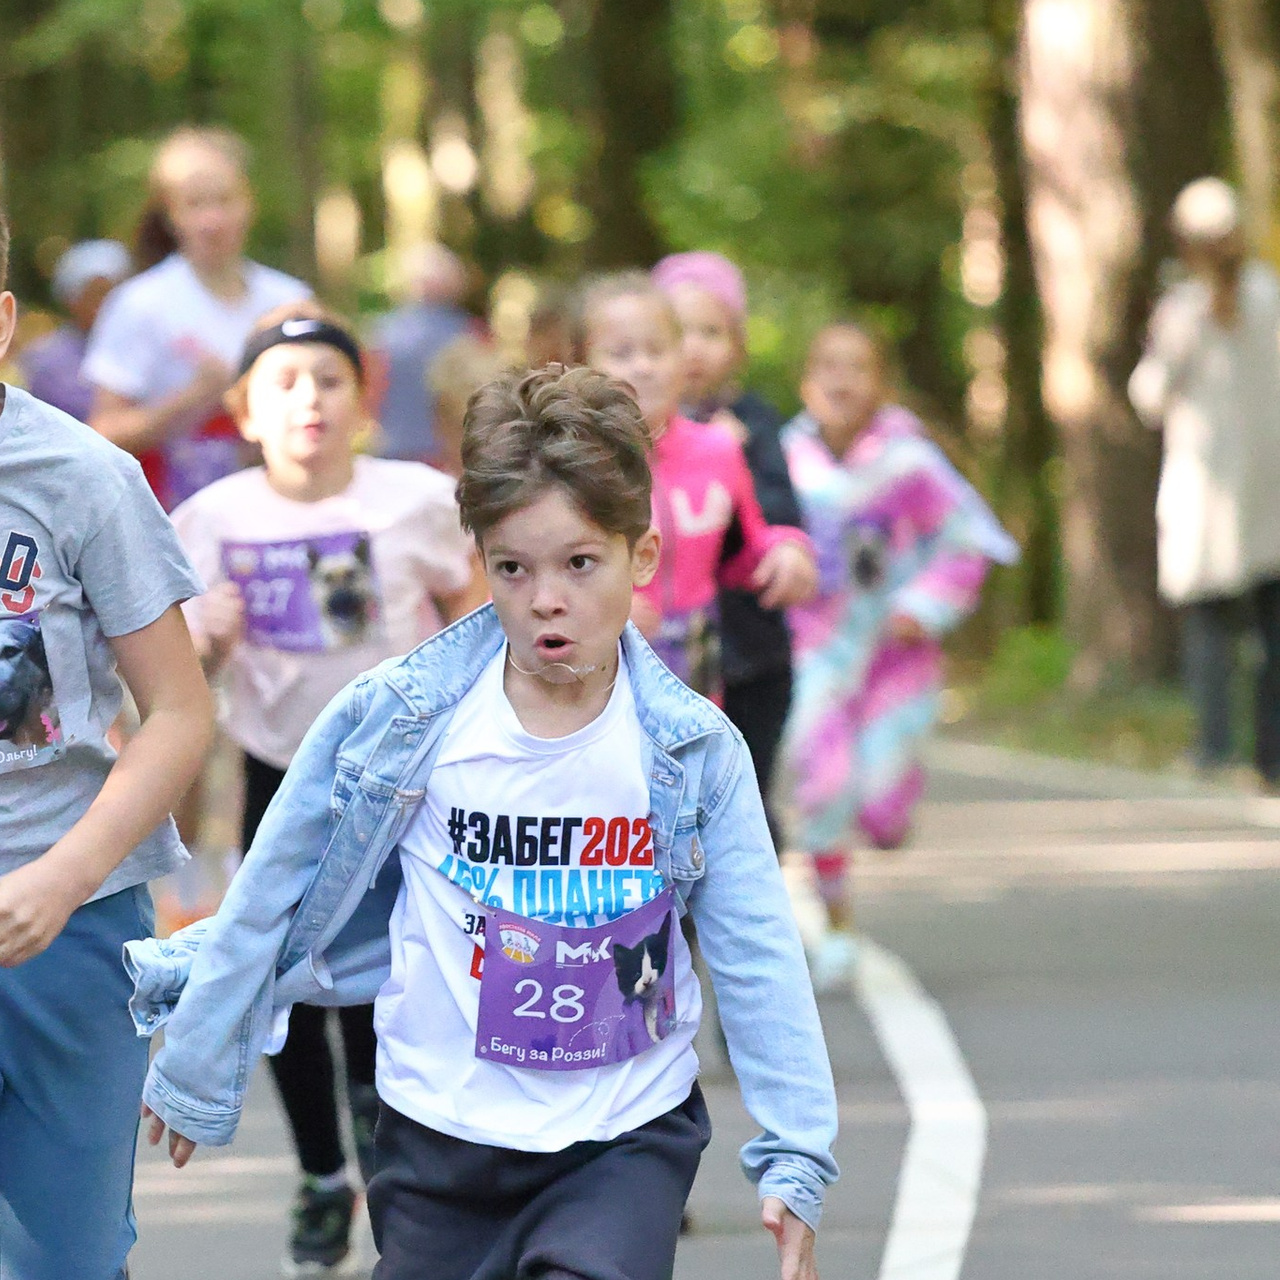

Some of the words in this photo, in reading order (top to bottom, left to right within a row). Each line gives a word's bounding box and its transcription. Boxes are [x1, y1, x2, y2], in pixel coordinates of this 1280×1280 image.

[513, 978, 585, 1023] 28
[490, 1036, 525, 1062] Бегу
[529, 1049, 548, 1062] за
[551, 1042, 607, 1062] Роззи!
